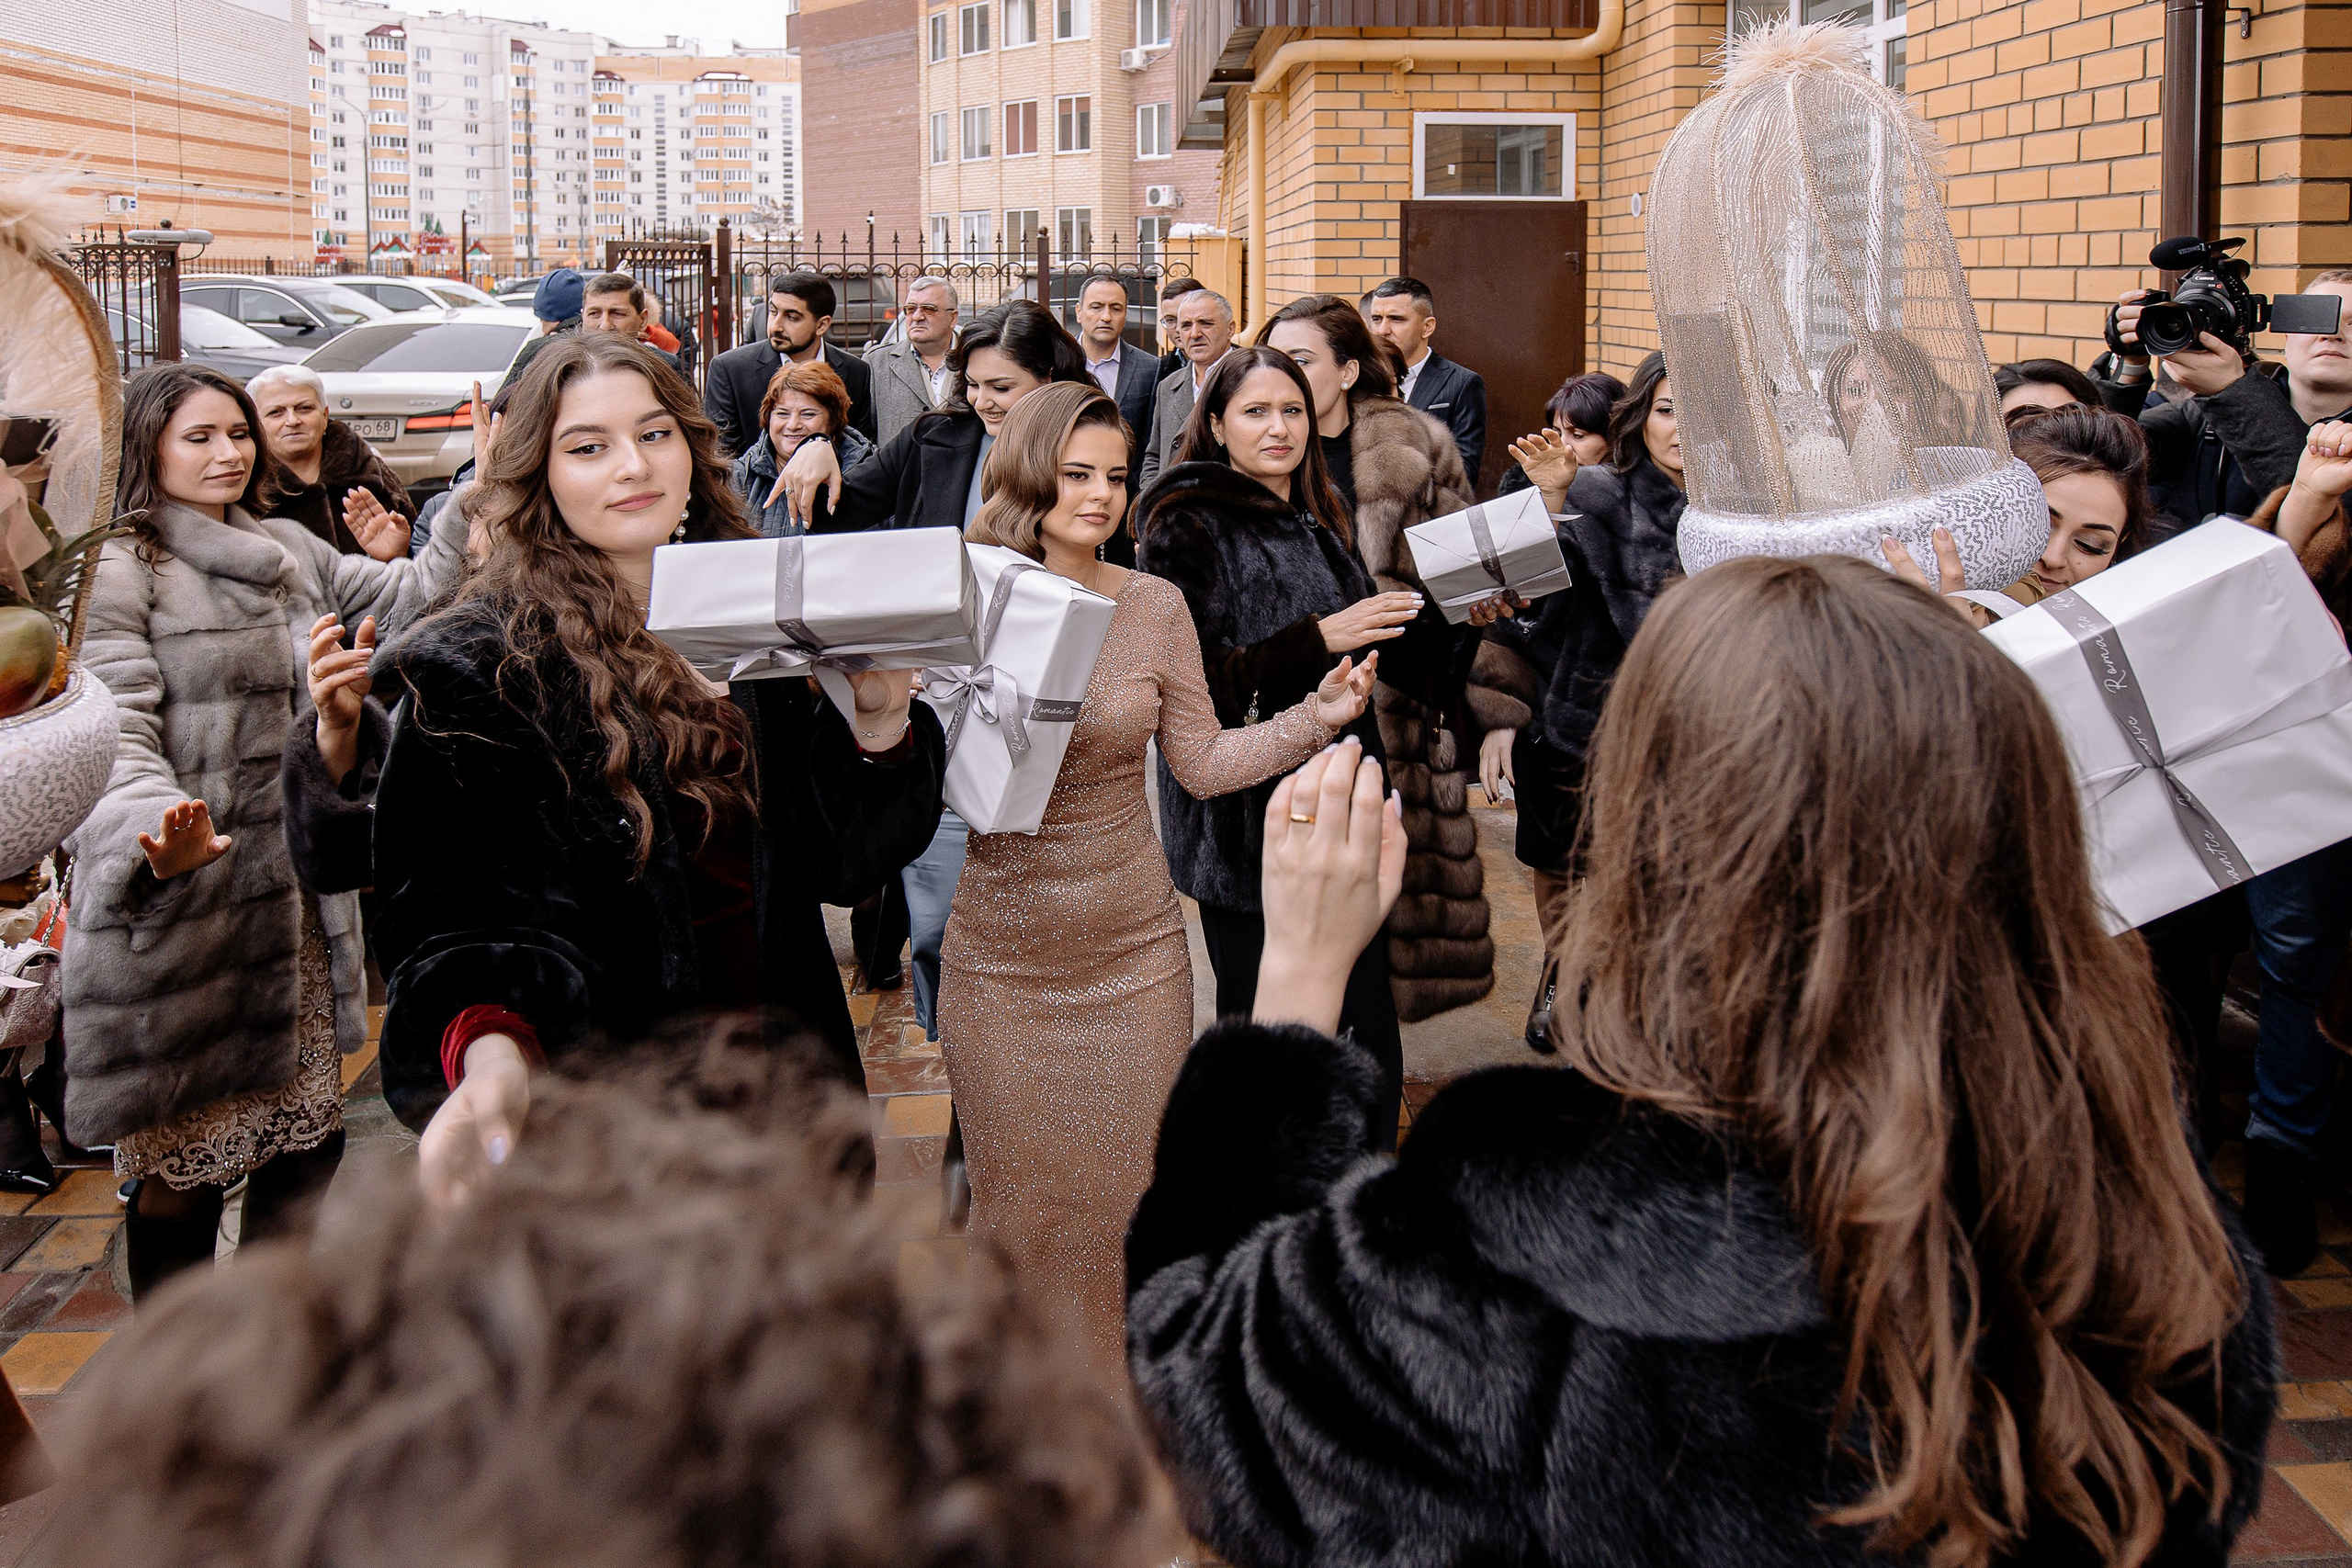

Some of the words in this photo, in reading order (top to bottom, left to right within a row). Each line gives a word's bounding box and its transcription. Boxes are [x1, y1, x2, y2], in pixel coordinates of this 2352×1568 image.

[376, 422, 390, 432] 68
[784, 536, 797, 603] omantic
[2077, 615, 2128, 694] Romantic
[1001, 689, 1025, 753] Romantic
[1031, 702, 1075, 717] Romantic
